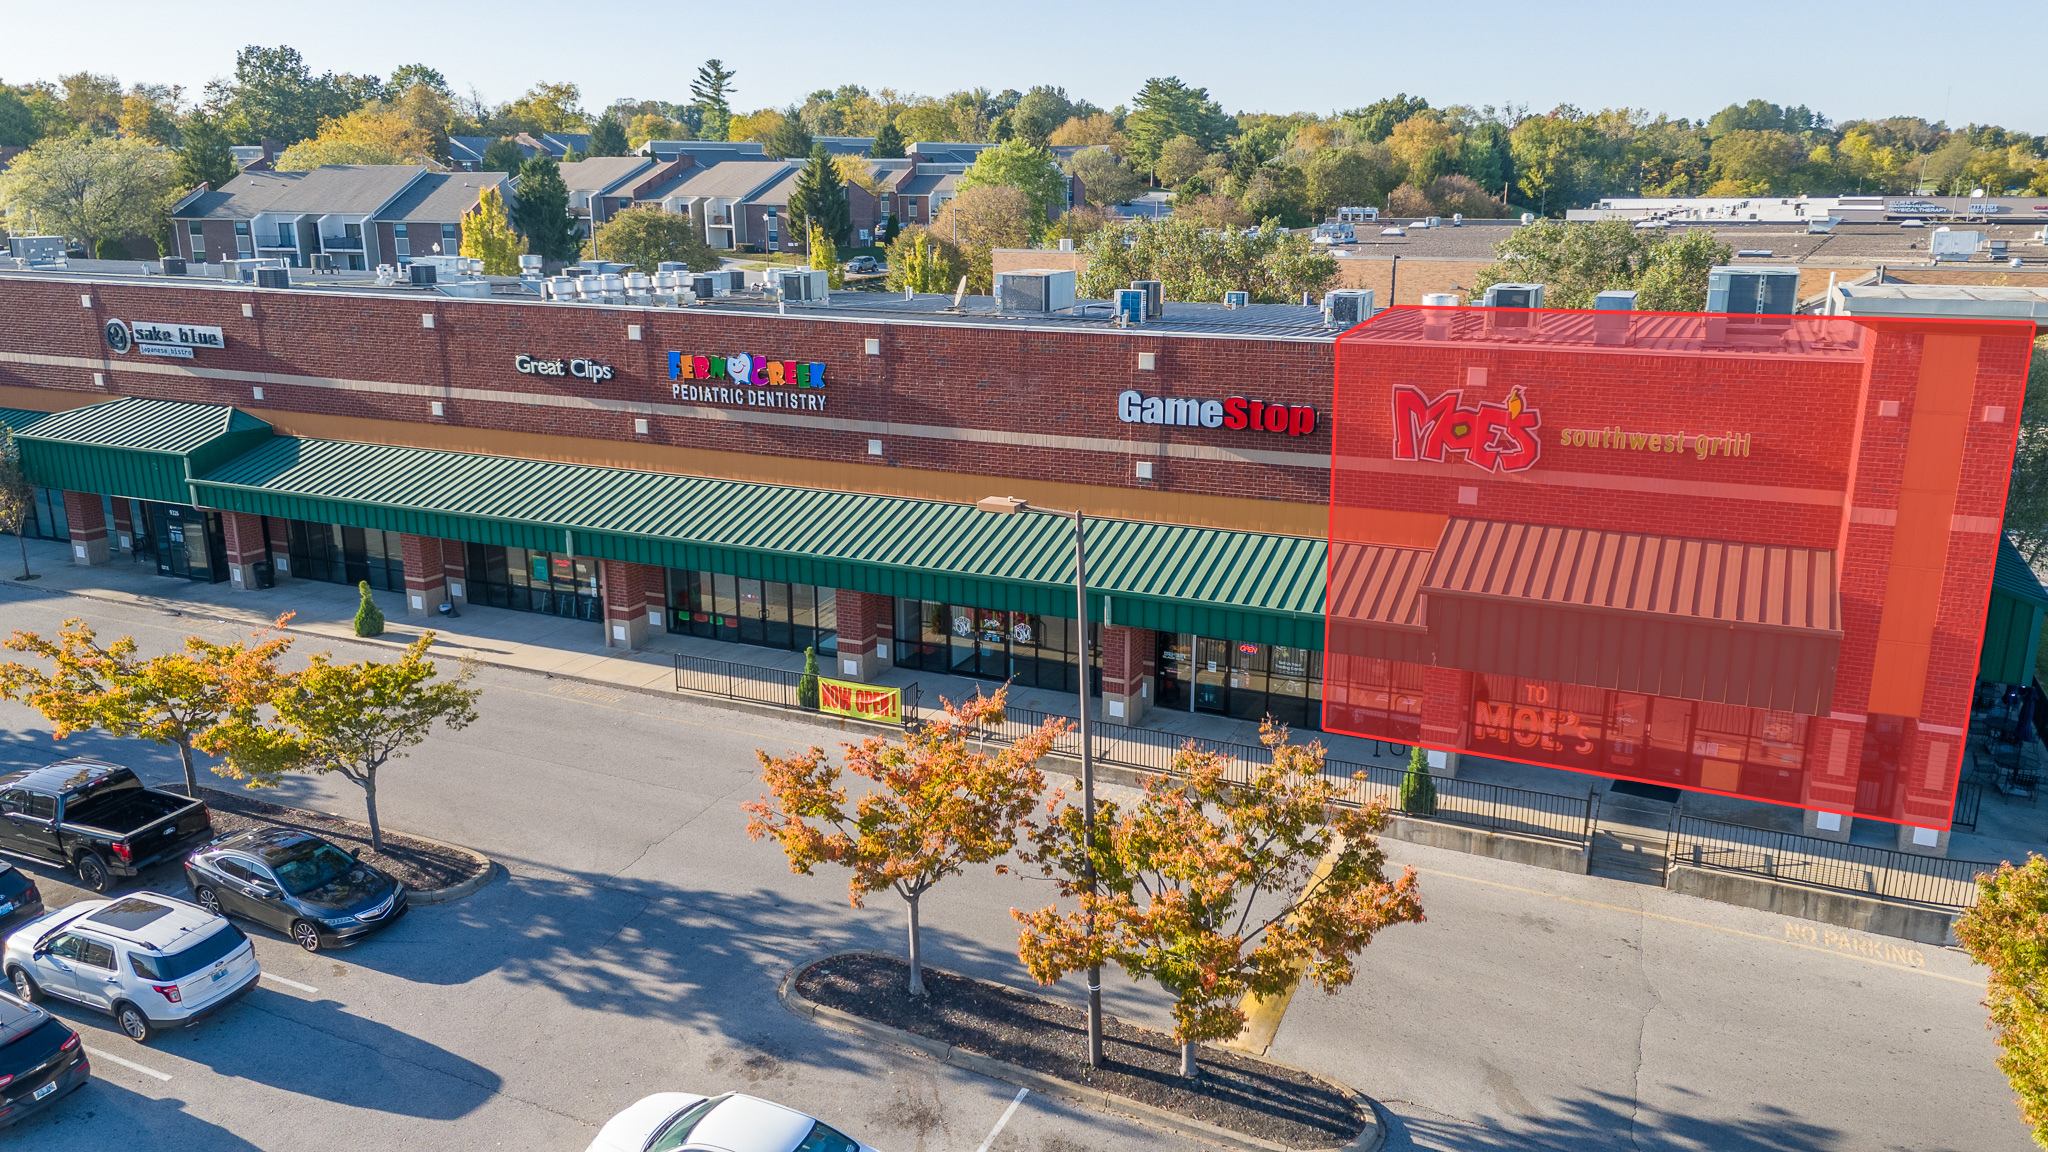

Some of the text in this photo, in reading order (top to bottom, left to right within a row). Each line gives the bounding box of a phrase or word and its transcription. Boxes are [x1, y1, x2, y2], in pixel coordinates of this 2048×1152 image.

[134, 326, 220, 346] sake blue
[141, 346, 192, 356] japanese bistro
[515, 354, 613, 384] Great Clips
[667, 350, 827, 389] FERN CREEK
[672, 383, 827, 411] PEDIATRIC DENTISTRY
[1118, 389, 1317, 437] GameStop
[1561, 426, 1751, 461] southwest grill
[1239, 644, 1258, 655] OPEN
[821, 682, 897, 717] NOW OPEN!
[1525, 684, 1550, 704] TO
[1785, 921, 1926, 968] NO PARKING
